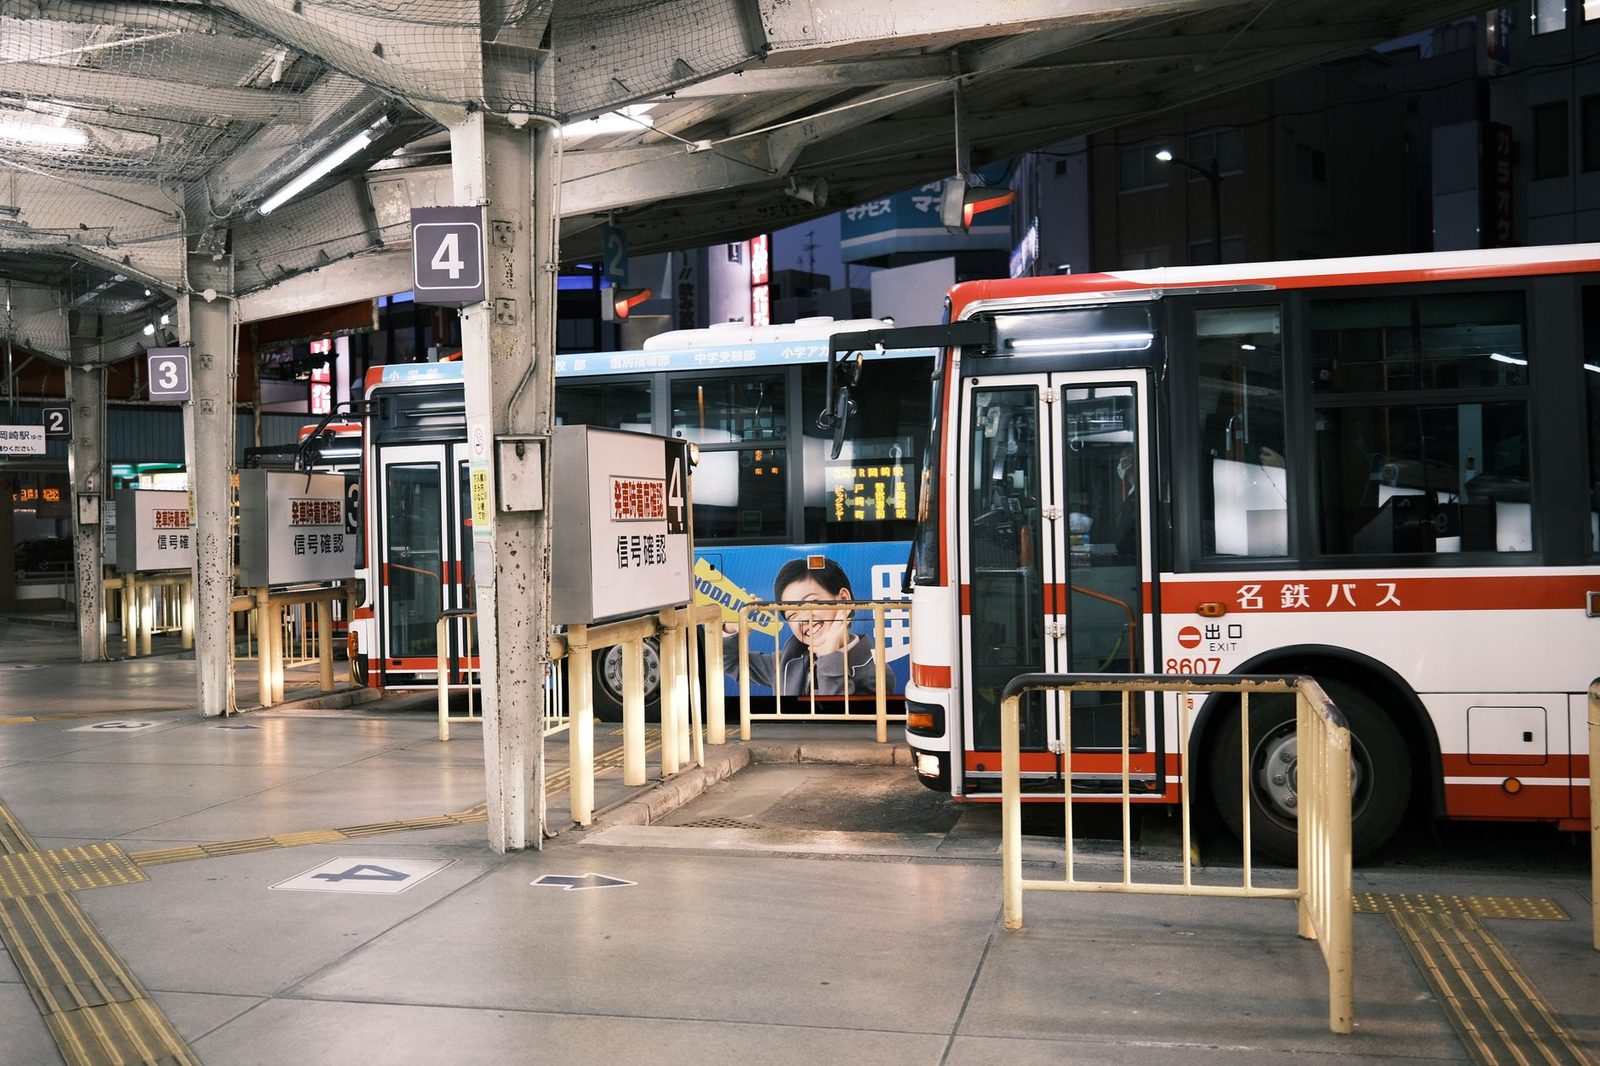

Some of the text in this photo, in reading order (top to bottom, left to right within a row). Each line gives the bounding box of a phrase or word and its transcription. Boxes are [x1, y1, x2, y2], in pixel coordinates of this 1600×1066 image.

[846, 199, 892, 221] マナビス
[431, 233, 465, 279] 4
[608, 234, 625, 277] 2
[694, 349, 755, 364] 中学受験部
[158, 361, 179, 389] 3
[49, 411, 64, 431] 2
[614, 480, 664, 519] 発車時着席確認
[668, 457, 684, 522] 4
[291, 500, 342, 524] 発車時着席確認
[157, 534, 189, 550] 信号確
[293, 533, 345, 555] 信号確認
[616, 533, 667, 569] 信号確認
[1236, 583, 1401, 609] 名鉄バス
[1205, 623, 1243, 639] 出口
[1209, 642, 1238, 652] EXIT
[1166, 658, 1221, 675] 8607
[310, 864, 412, 882] 4
